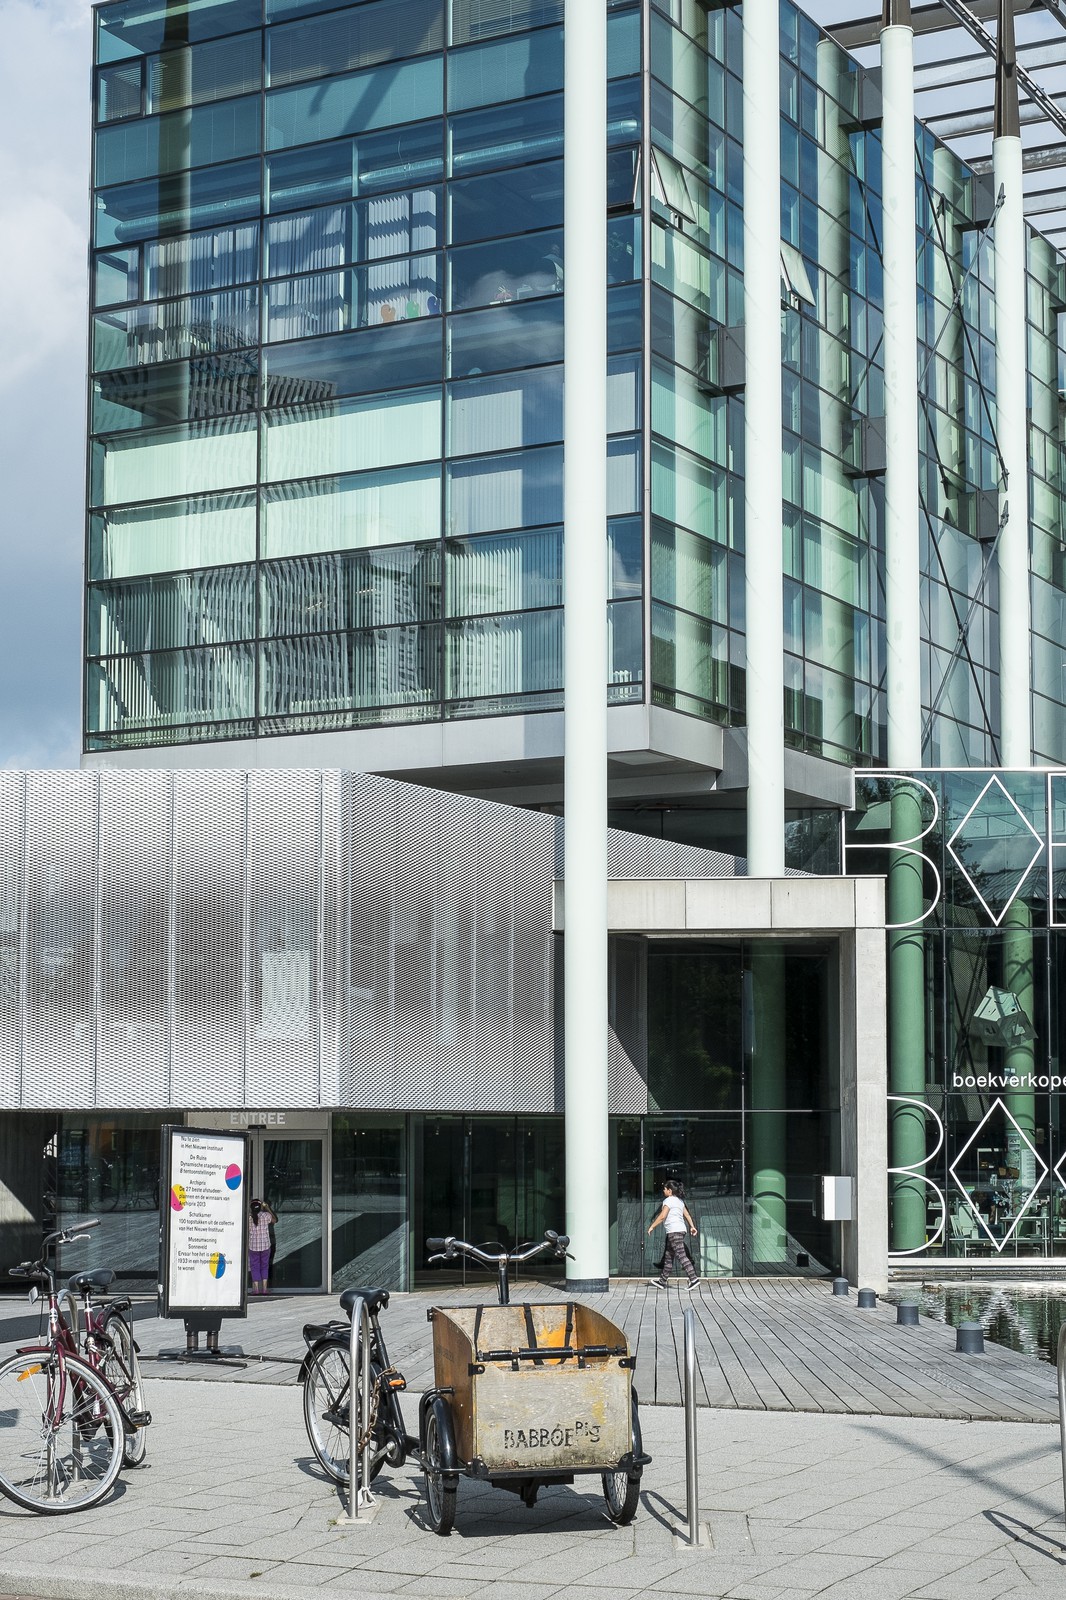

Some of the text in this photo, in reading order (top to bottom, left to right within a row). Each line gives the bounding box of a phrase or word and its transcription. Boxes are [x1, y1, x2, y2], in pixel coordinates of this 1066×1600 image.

[842, 774, 1066, 928] BO
[230, 1112, 286, 1125] ENTREE
[887, 1096, 1066, 1256] BO
